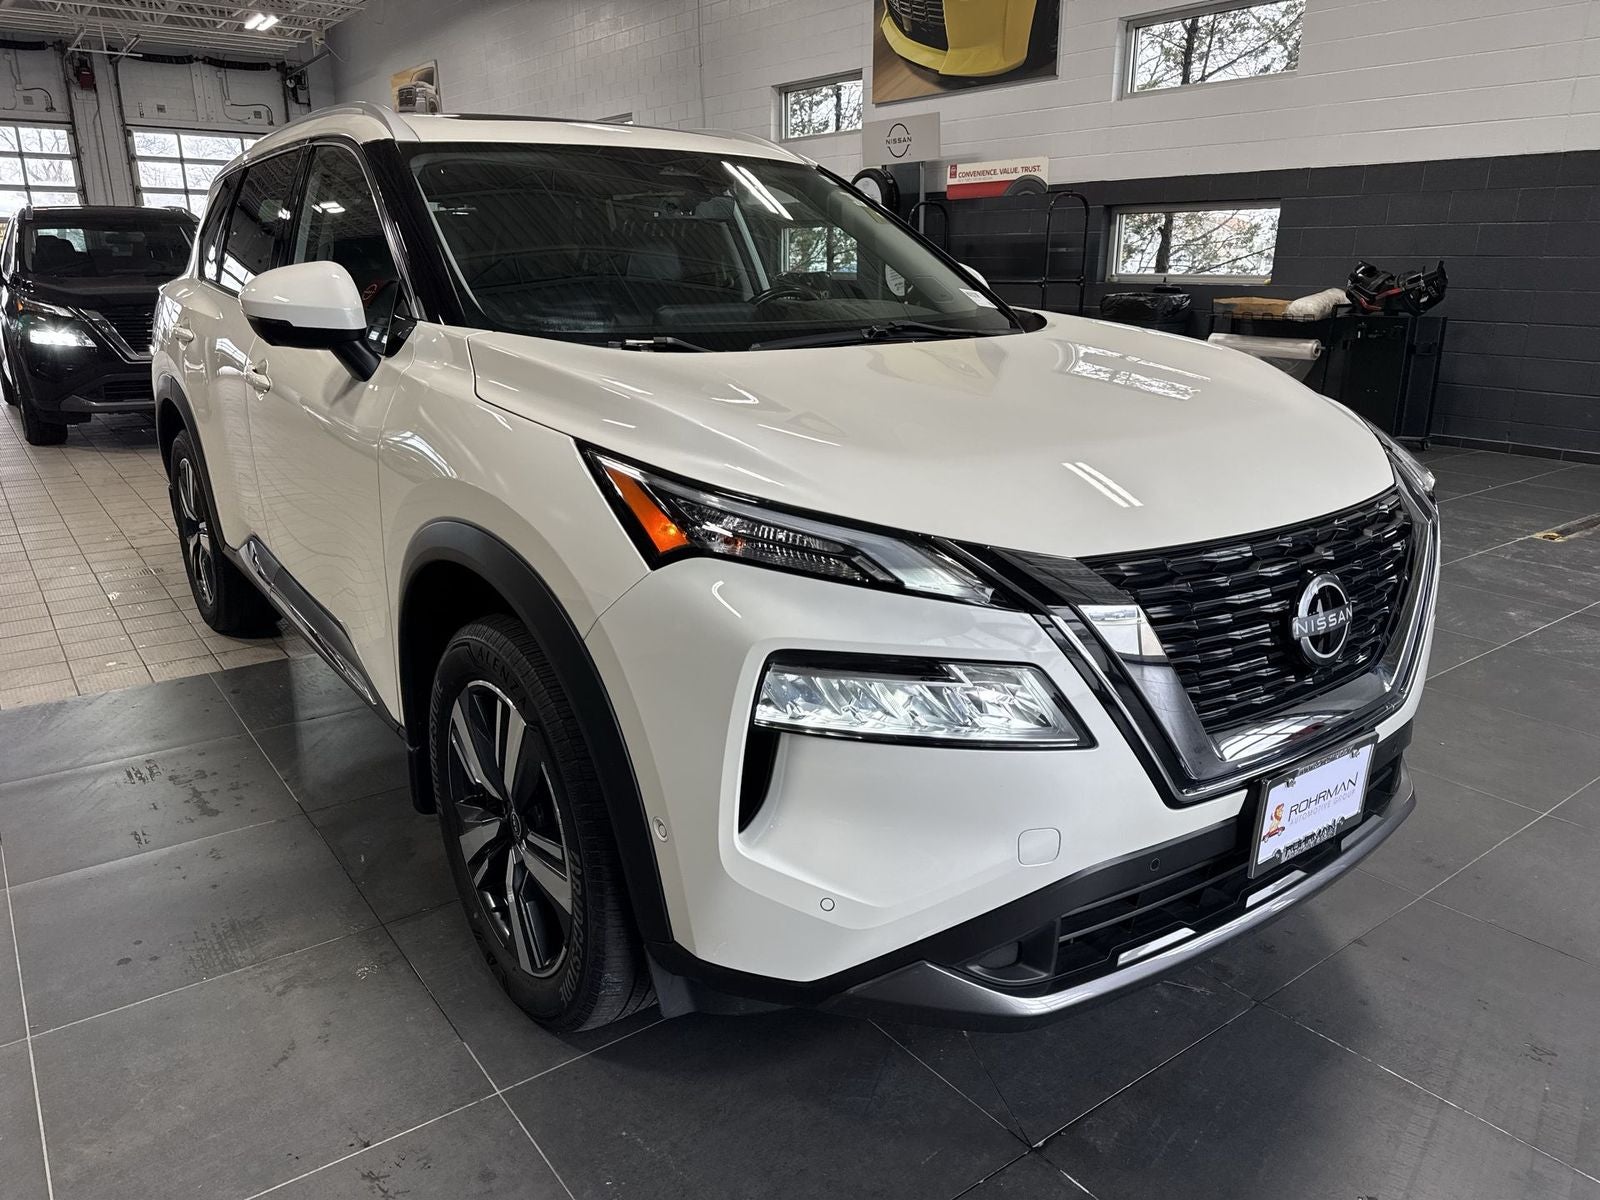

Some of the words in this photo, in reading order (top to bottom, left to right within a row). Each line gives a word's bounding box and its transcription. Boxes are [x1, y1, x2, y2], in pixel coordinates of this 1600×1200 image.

[958, 168, 999, 179] CONVENIENCE.
[999, 166, 1020, 175] VALUE.
[1021, 165, 1042, 173] TRUST.
[1295, 604, 1353, 635] NISSAN
[1288, 771, 1359, 822] ROHRMAN
